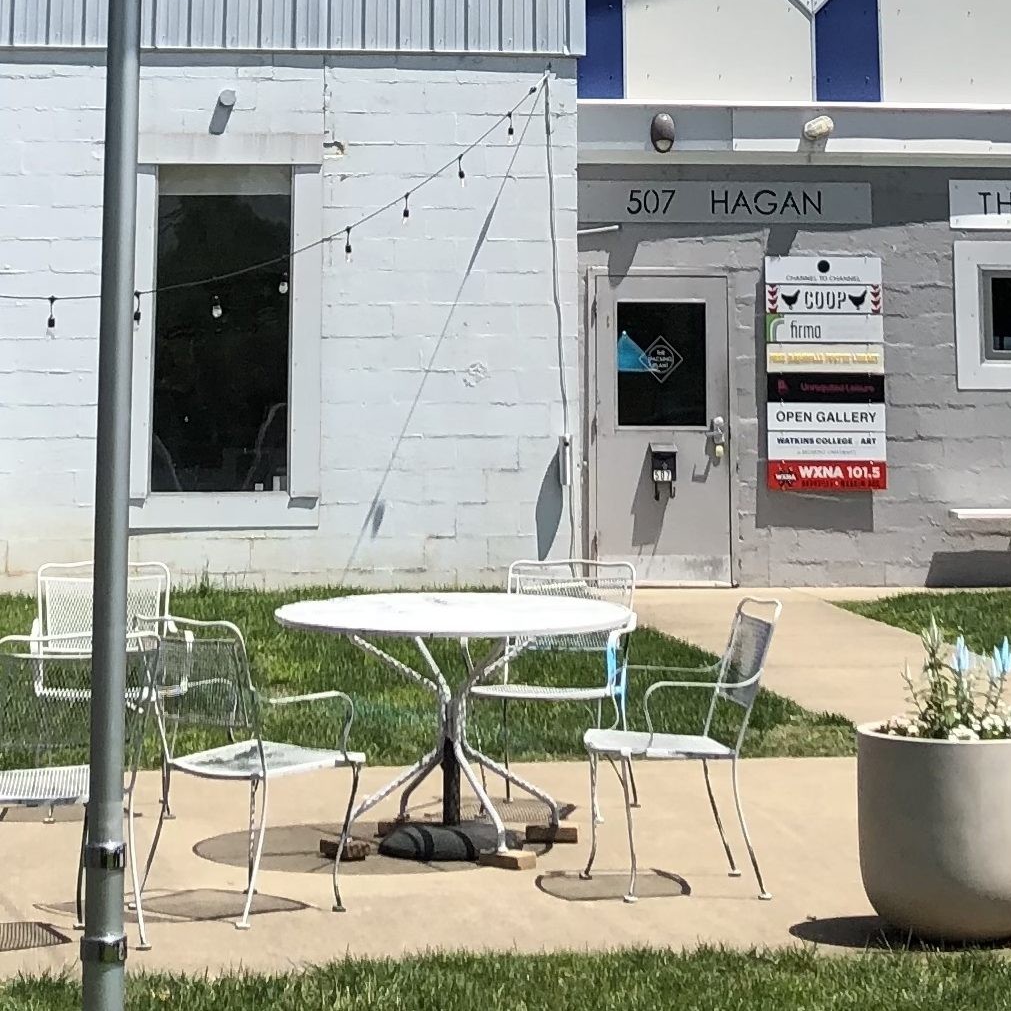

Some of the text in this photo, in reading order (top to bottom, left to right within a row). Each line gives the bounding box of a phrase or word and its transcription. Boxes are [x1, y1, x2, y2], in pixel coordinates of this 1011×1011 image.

[627, 189, 822, 215] 507 HAGAN
[804, 291, 847, 309] COOP
[790, 320, 822, 339] firma
[776, 411, 876, 423] OPEN GALLERY
[777, 437, 876, 445] WATKINS COLLEGE ART
[654, 470, 671, 481] 507
[798, 465, 880, 479] WXNA 101.5
